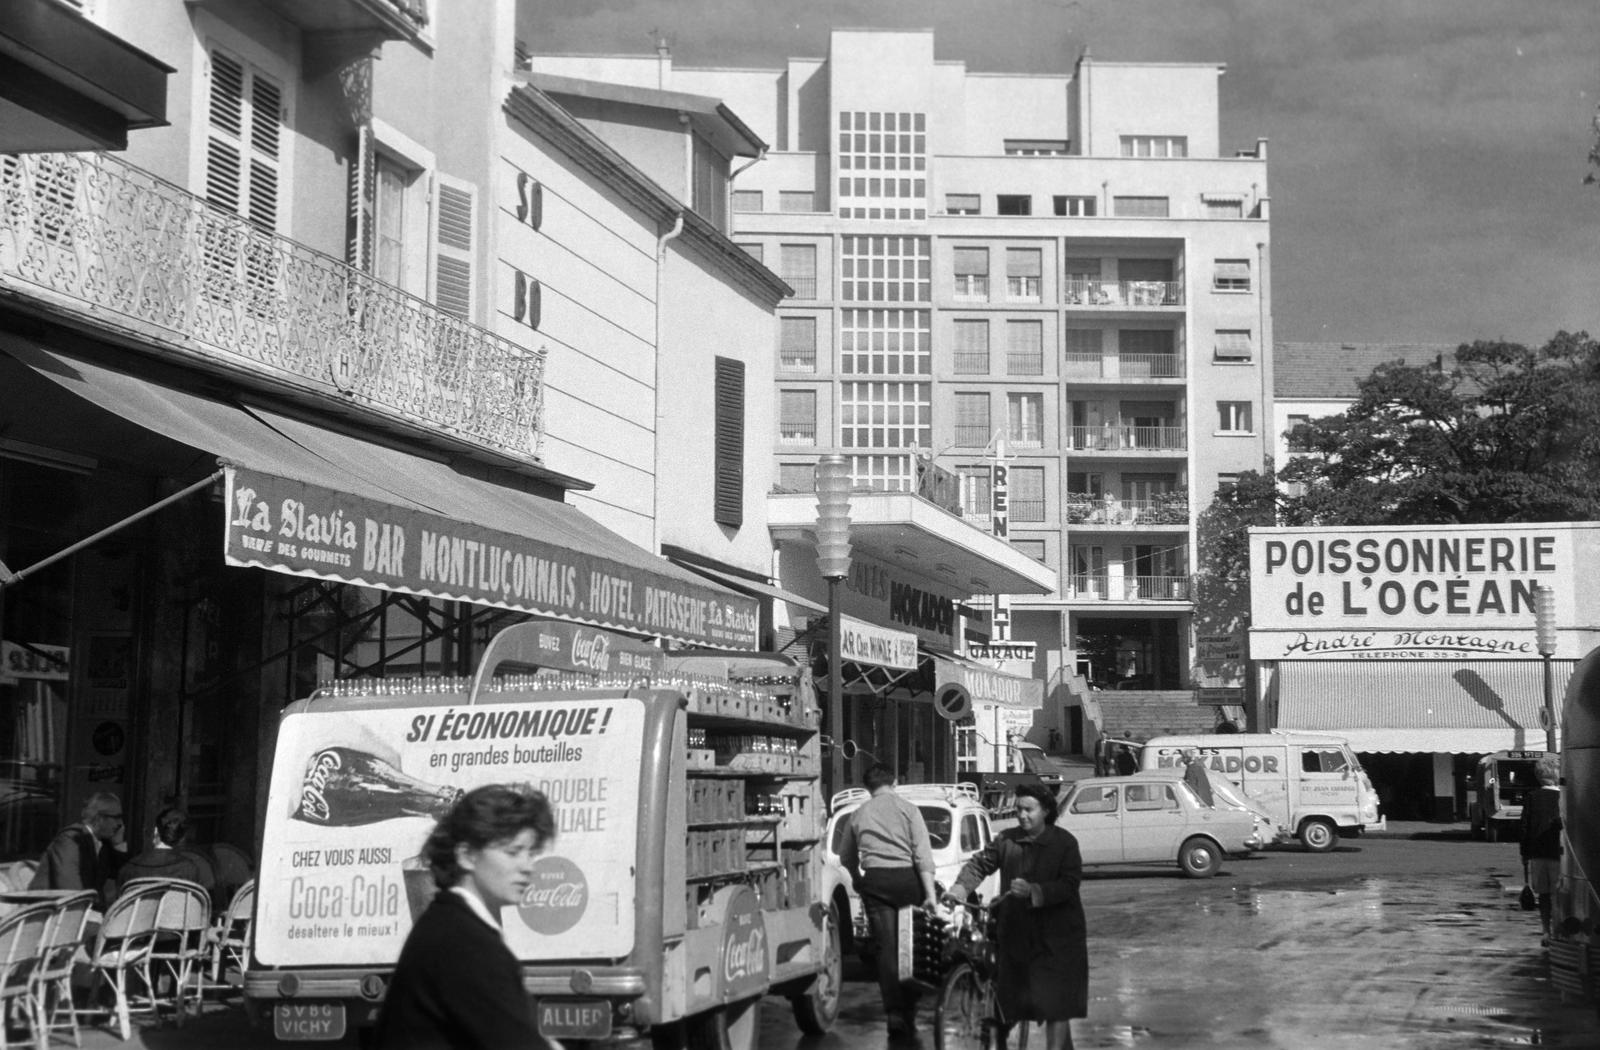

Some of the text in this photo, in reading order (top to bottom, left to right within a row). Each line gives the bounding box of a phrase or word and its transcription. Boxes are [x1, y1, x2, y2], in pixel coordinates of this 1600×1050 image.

[231, 486, 357, 549] La Slavia
[277, 542, 297, 558] DES
[301, 548, 350, 567] GOURMETS
[1265, 536, 1556, 575] POISSONNERIE
[363, 518, 405, 578] BAR
[590, 571, 634, 620] HOTEL
[645, 586, 706, 637] PATISSERIE
[1285, 574, 1540, 616] de L'OCÉAN
[970, 645, 1034, 660] GARAGE
[1283, 631, 1531, 656] André Montagne
[964, 670, 1021, 702] MOKADOR
[406, 714, 436, 742] SI
[435, 708, 599, 742] ÉCONOMIQUE
[430, 741, 583, 773] en grandes bouteilles
[539, 777, 608, 803] DOUBLE
[292, 847, 391, 868] CHEZ VOUS AUSSI
[289, 874, 398, 919] Coca-Cola
[343, 923, 353, 937] le
[357, 923, 391, 937] mieux
[282, 1020, 332, 1034] VICHY
